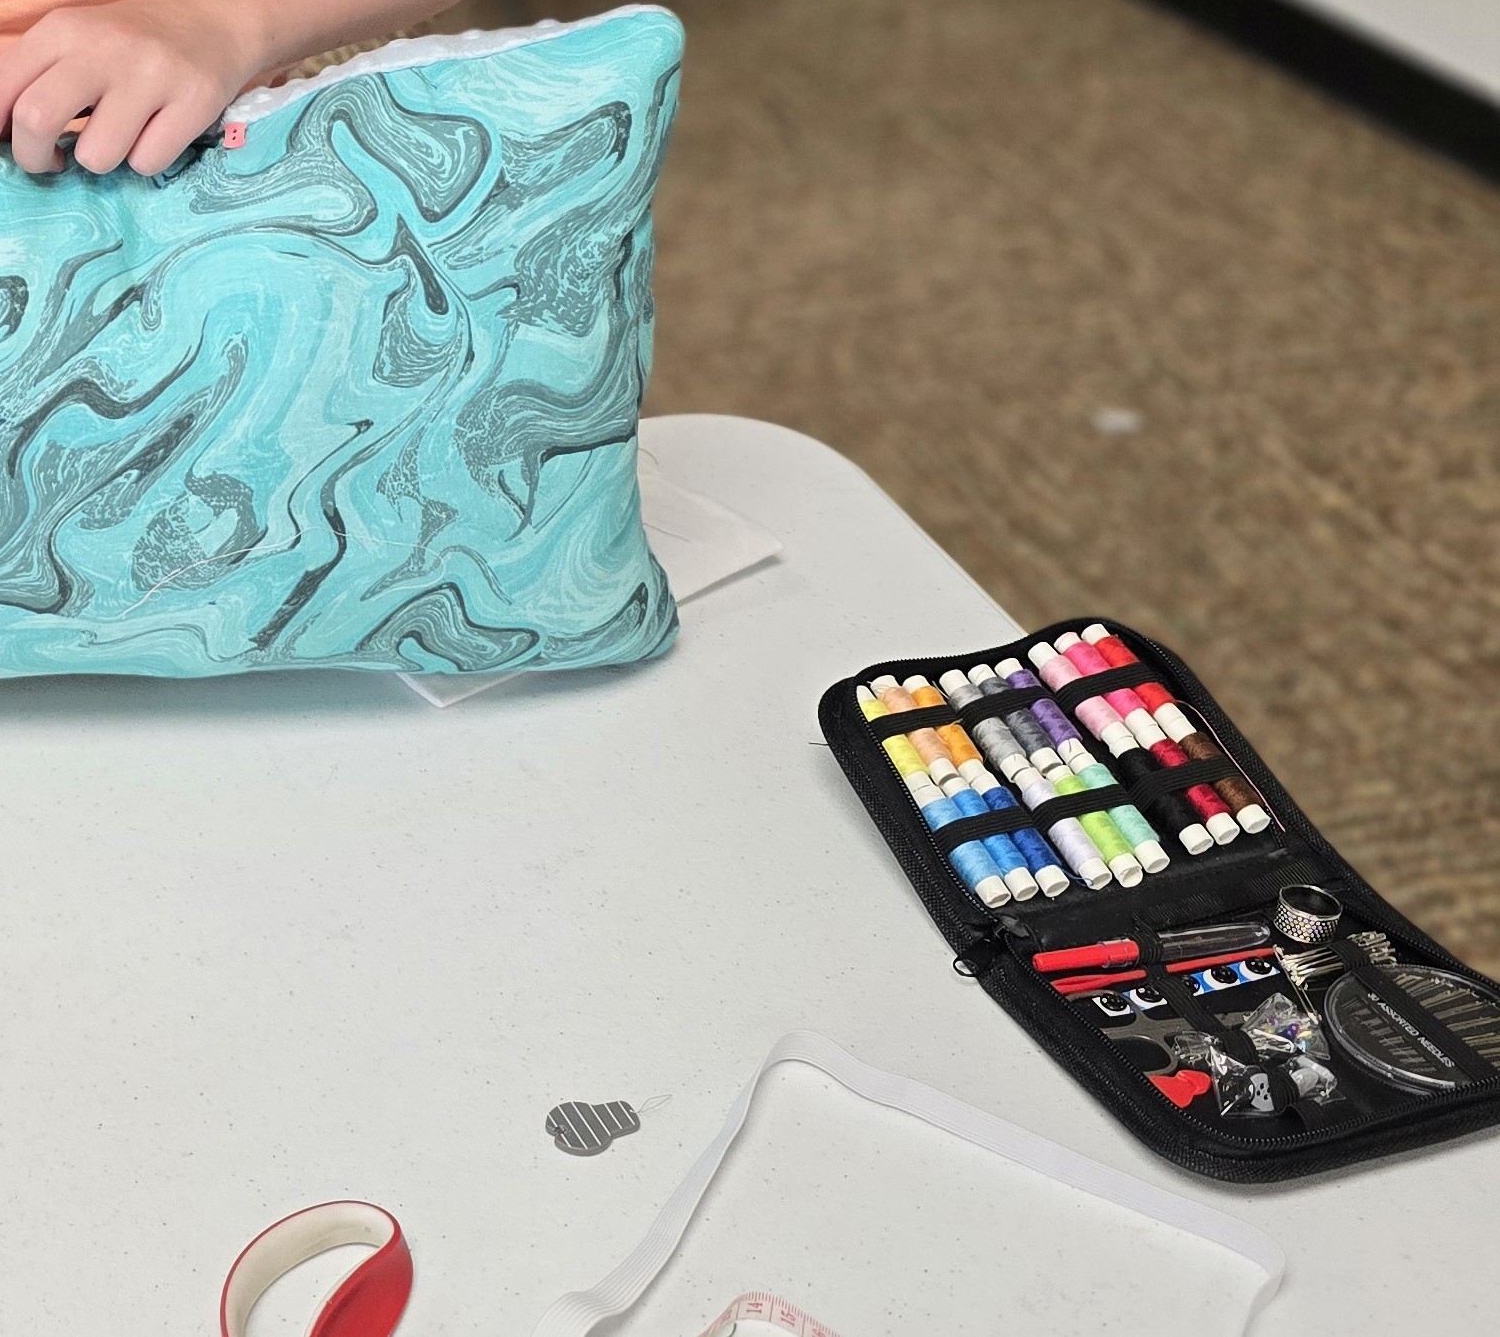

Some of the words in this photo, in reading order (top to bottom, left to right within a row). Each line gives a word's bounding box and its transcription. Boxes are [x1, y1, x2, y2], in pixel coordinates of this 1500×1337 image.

[1377, 1003, 1420, 1036] ASSORTED
[1417, 1036, 1455, 1068] NEEDLES
[746, 1302, 763, 1314] 14
[781, 1310, 796, 1327] 15
